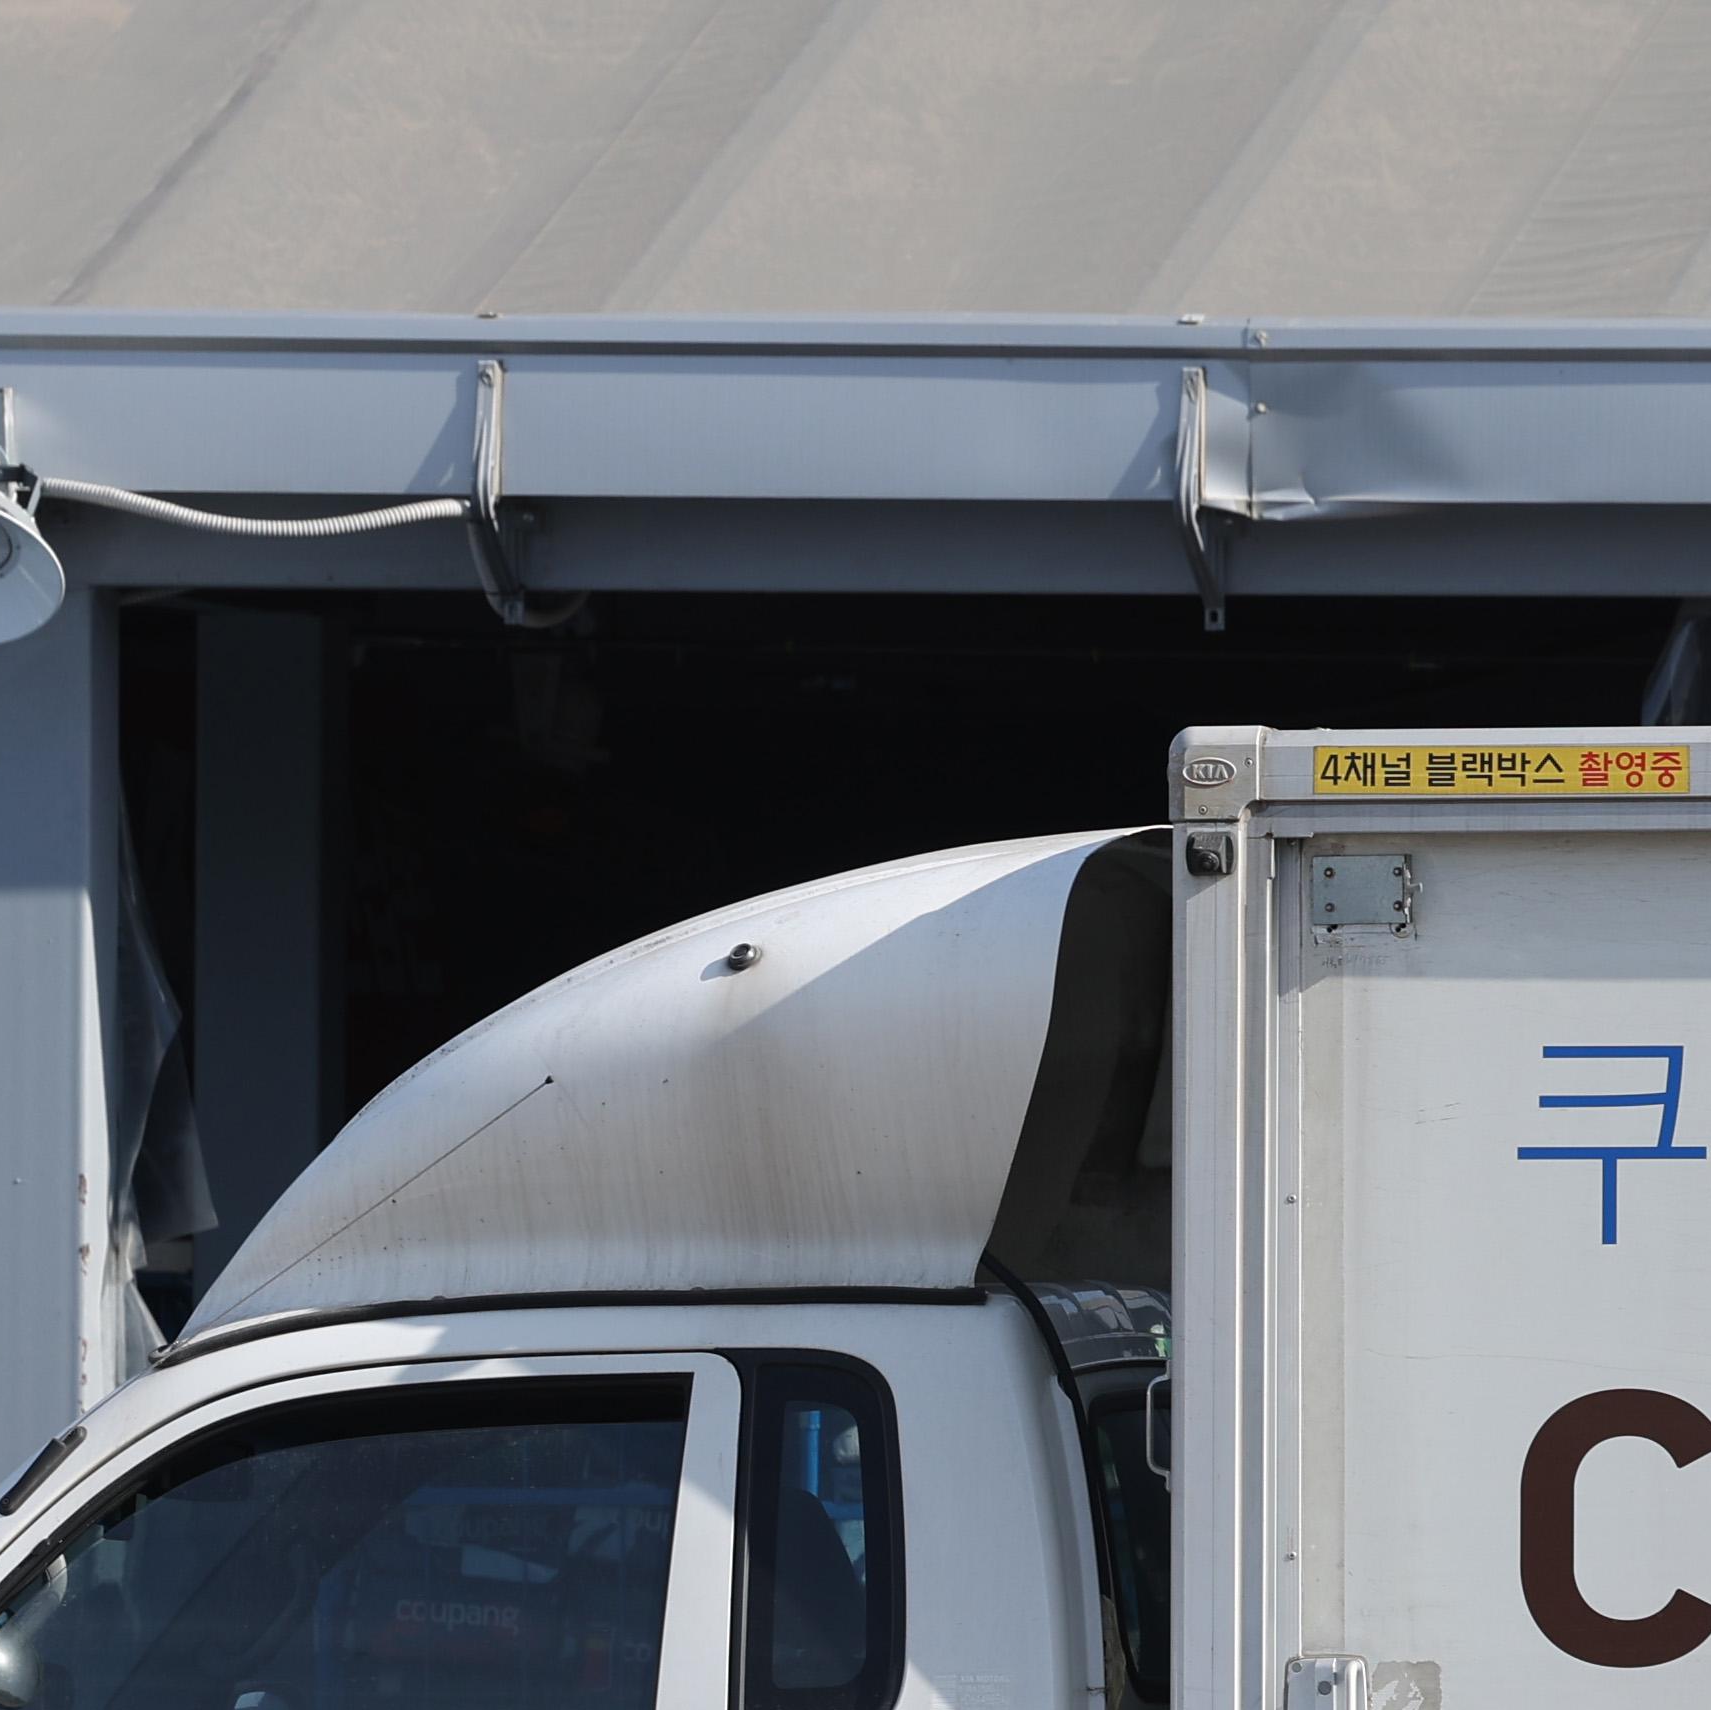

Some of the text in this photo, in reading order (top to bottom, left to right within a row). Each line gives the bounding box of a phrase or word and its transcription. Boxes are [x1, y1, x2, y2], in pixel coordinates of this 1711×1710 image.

[1190, 761, 1230, 781] KIA
[1321, 751, 1683, 788] 4채널 블랙박스 촬영중
